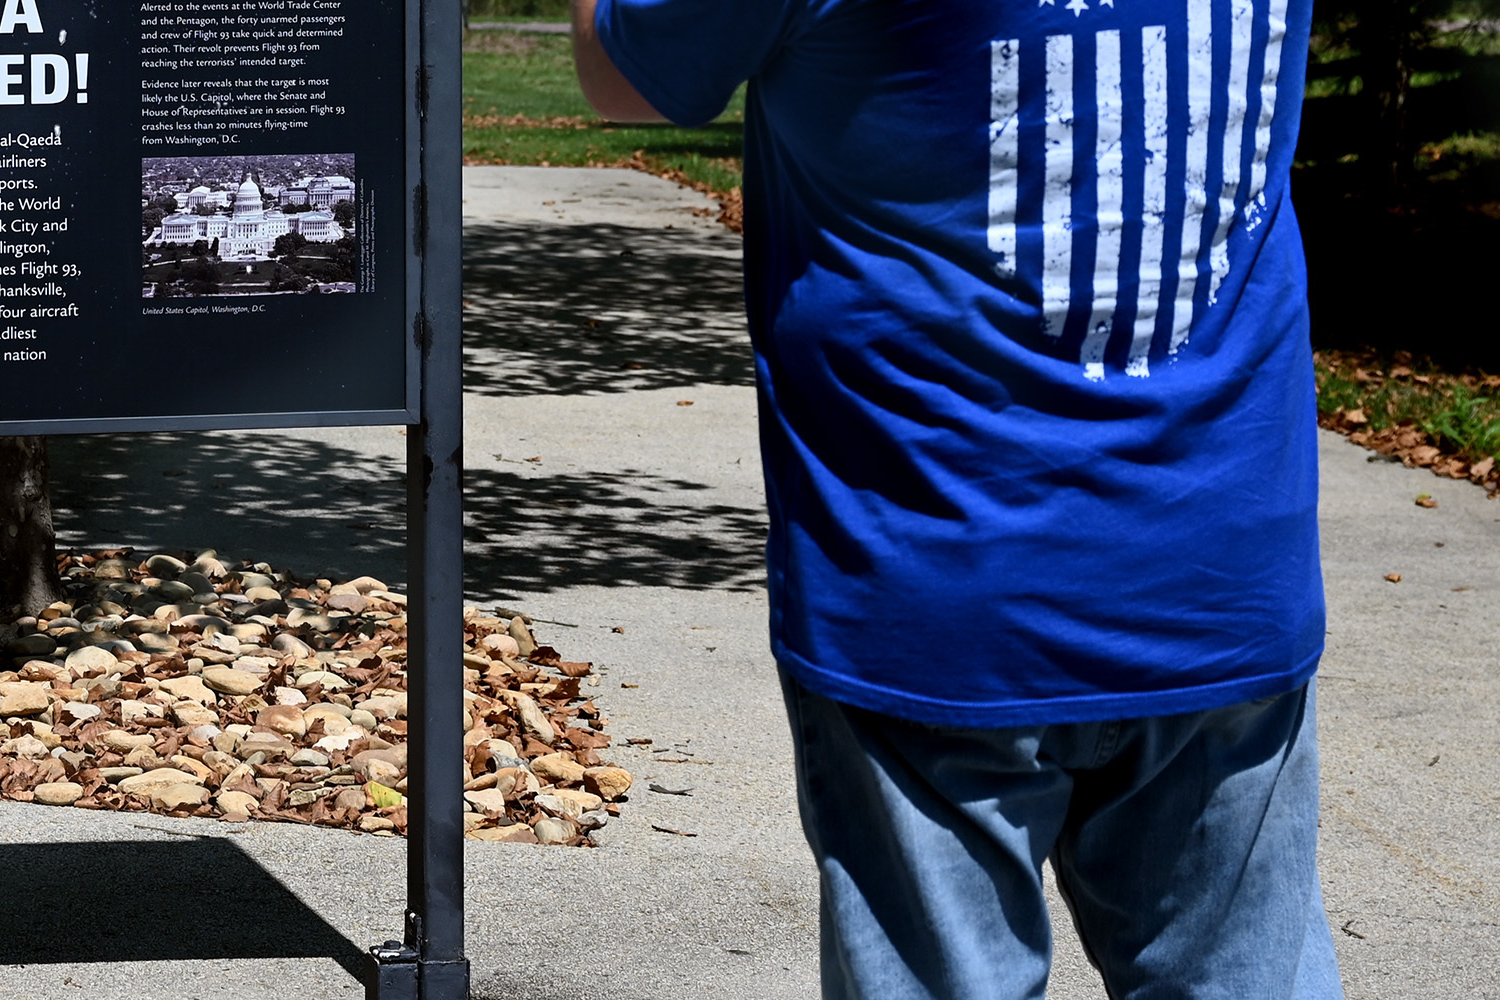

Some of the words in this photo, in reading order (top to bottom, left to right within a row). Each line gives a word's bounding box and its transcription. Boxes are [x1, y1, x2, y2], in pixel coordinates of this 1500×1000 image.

[140, 2, 172, 11] Alerted
[186, 2, 200, 11] the
[202, 3, 229, 11] events
[242, 1, 256, 10] the
[257, 0, 284, 9] World
[286, 0, 310, 9] Trade
[312, 0, 341, 9] Center
[140, 16, 158, 25] and
[160, 16, 174, 25] the
[176, 16, 218, 27] Pentagon,
[221, 15, 235, 24] the
[237, 14, 258, 26] forty
[260, 14, 298, 24] unarmed
[300, 16, 346, 25] passengers
[0, 134, 62, 148] al-Qaeda
[18, 196, 60, 210] World
[10, 218, 38, 236] City
[42, 217, 67, 231] and
[21, 261, 58, 279] Flight
[61, 264, 81, 277] 93,
